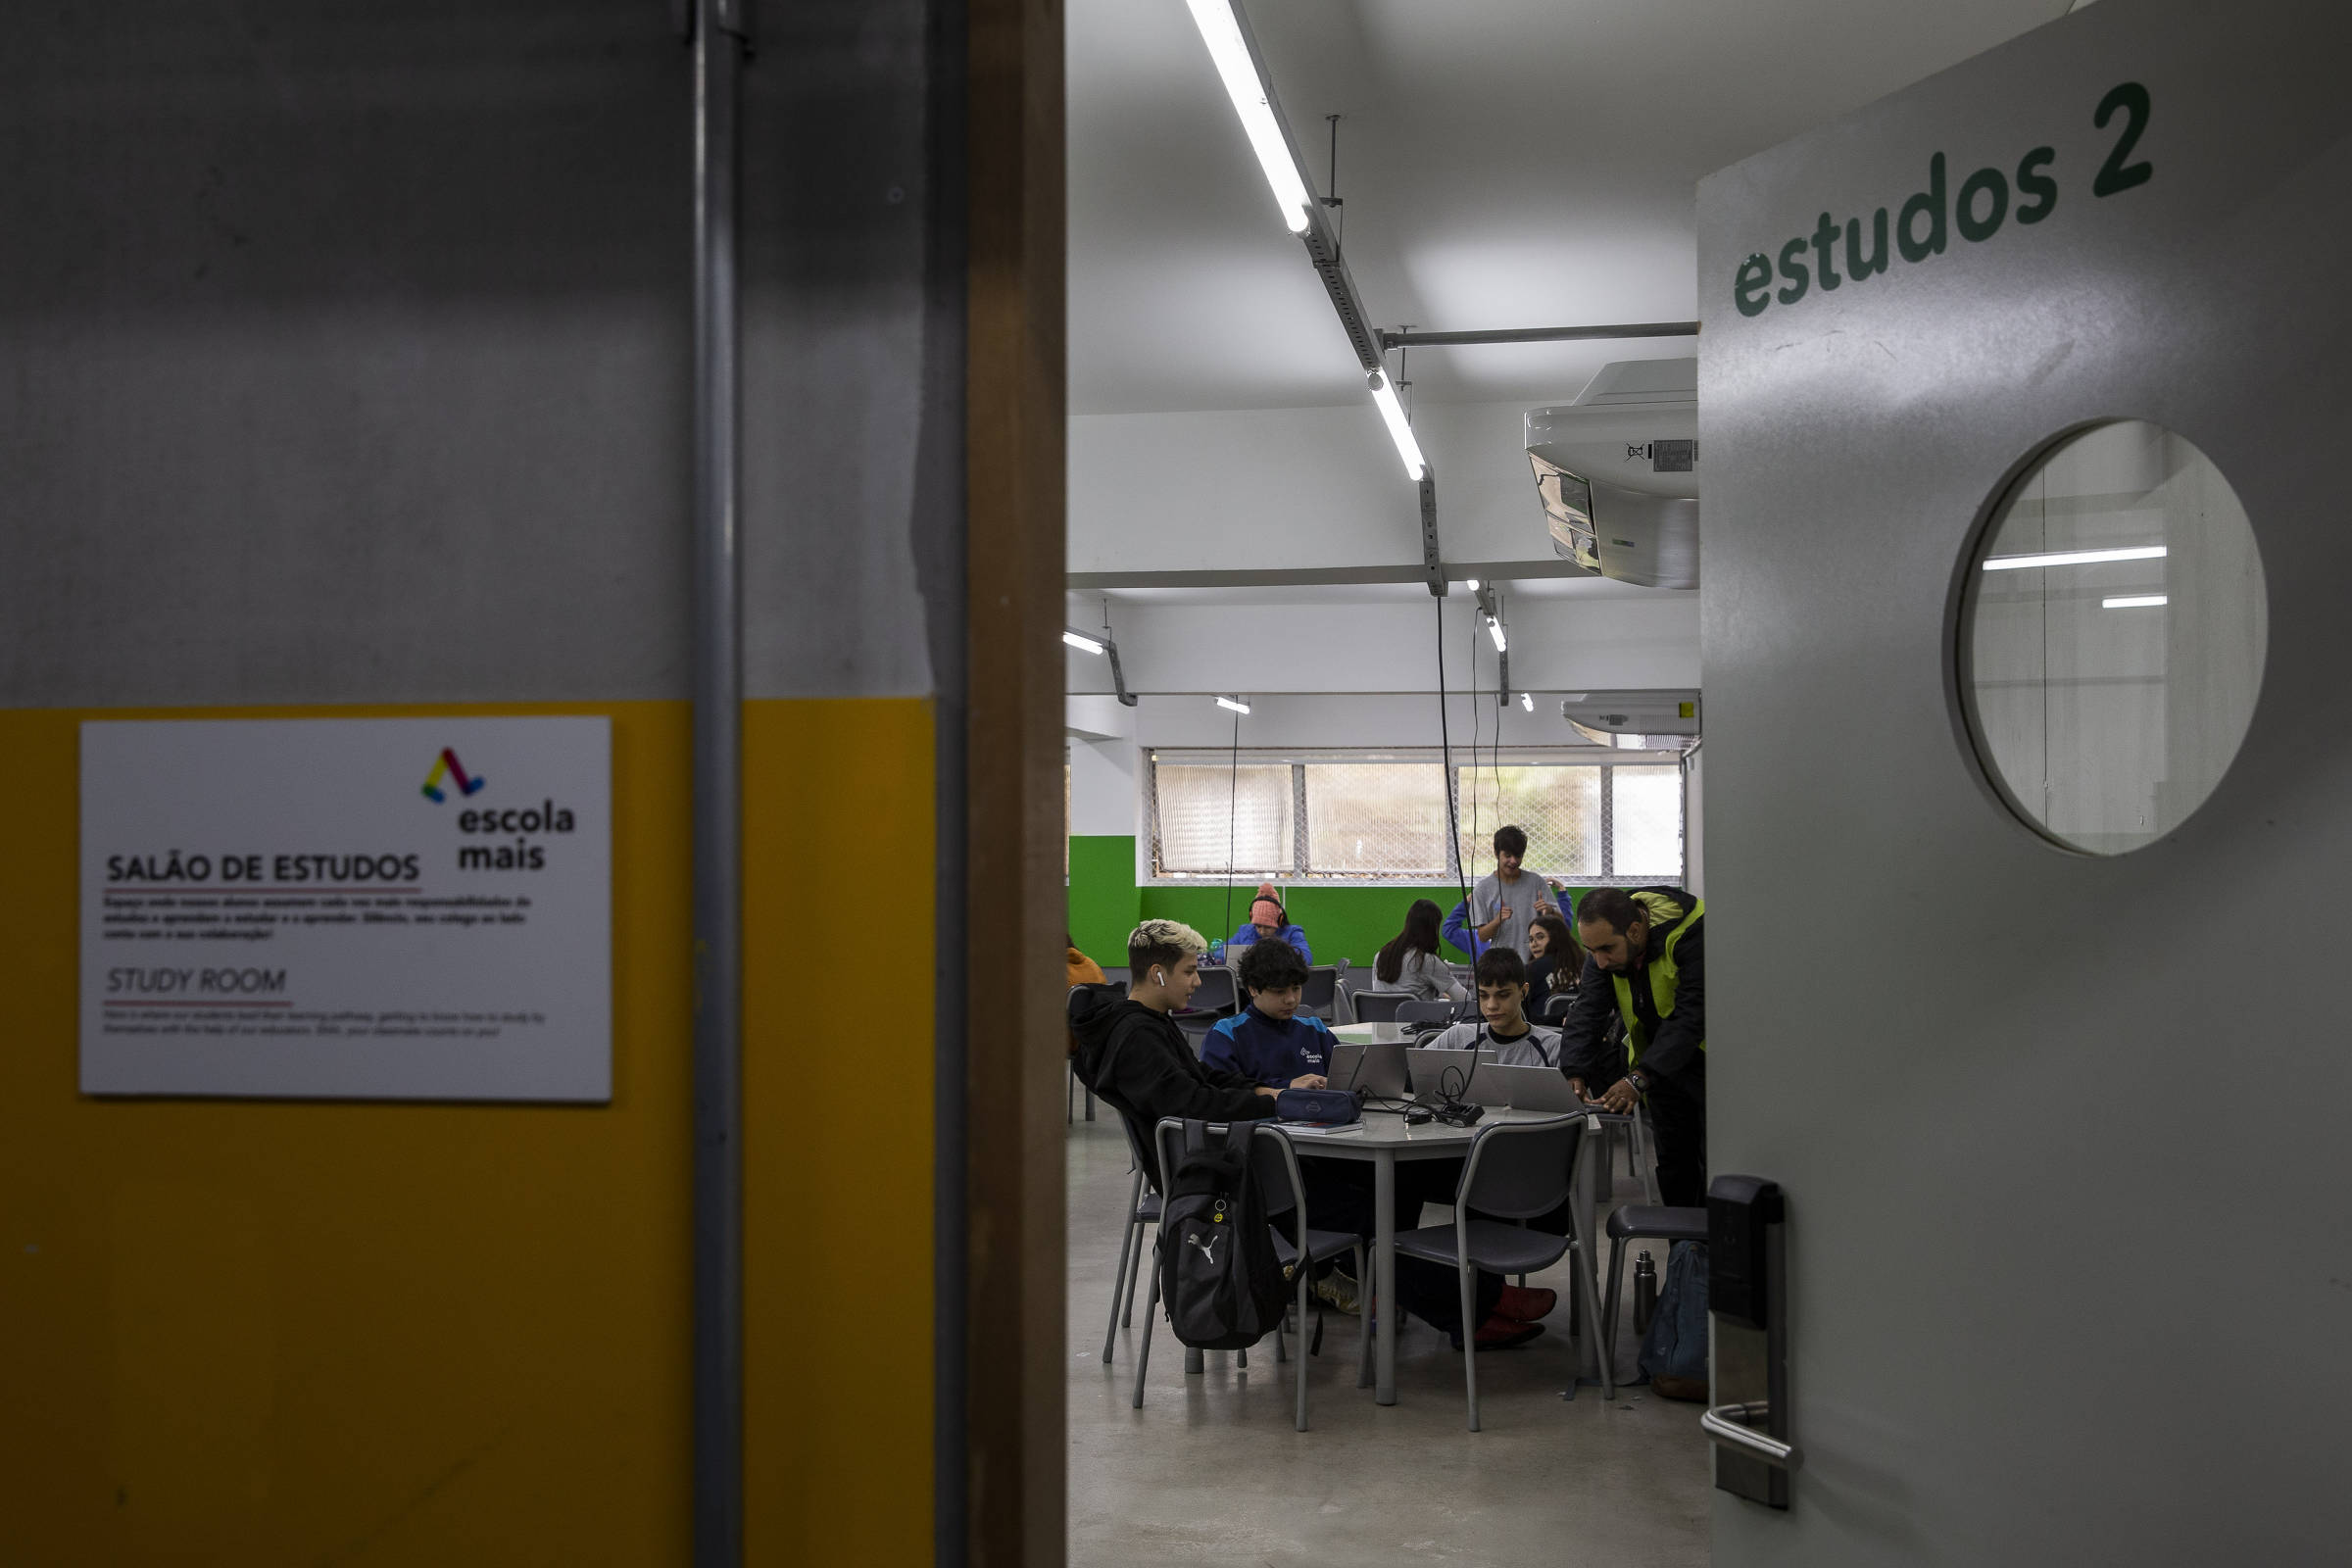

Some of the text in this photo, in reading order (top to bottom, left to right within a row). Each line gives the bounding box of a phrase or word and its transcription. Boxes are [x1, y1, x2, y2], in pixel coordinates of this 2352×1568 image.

[1735, 81, 2154, 318] estudos 2
[459, 799, 575, 835] escola
[107, 850, 419, 882] SALÃO DE ESTUDOS
[459, 837, 546, 871] mais
[107, 967, 287, 995] STUDY ROOM
